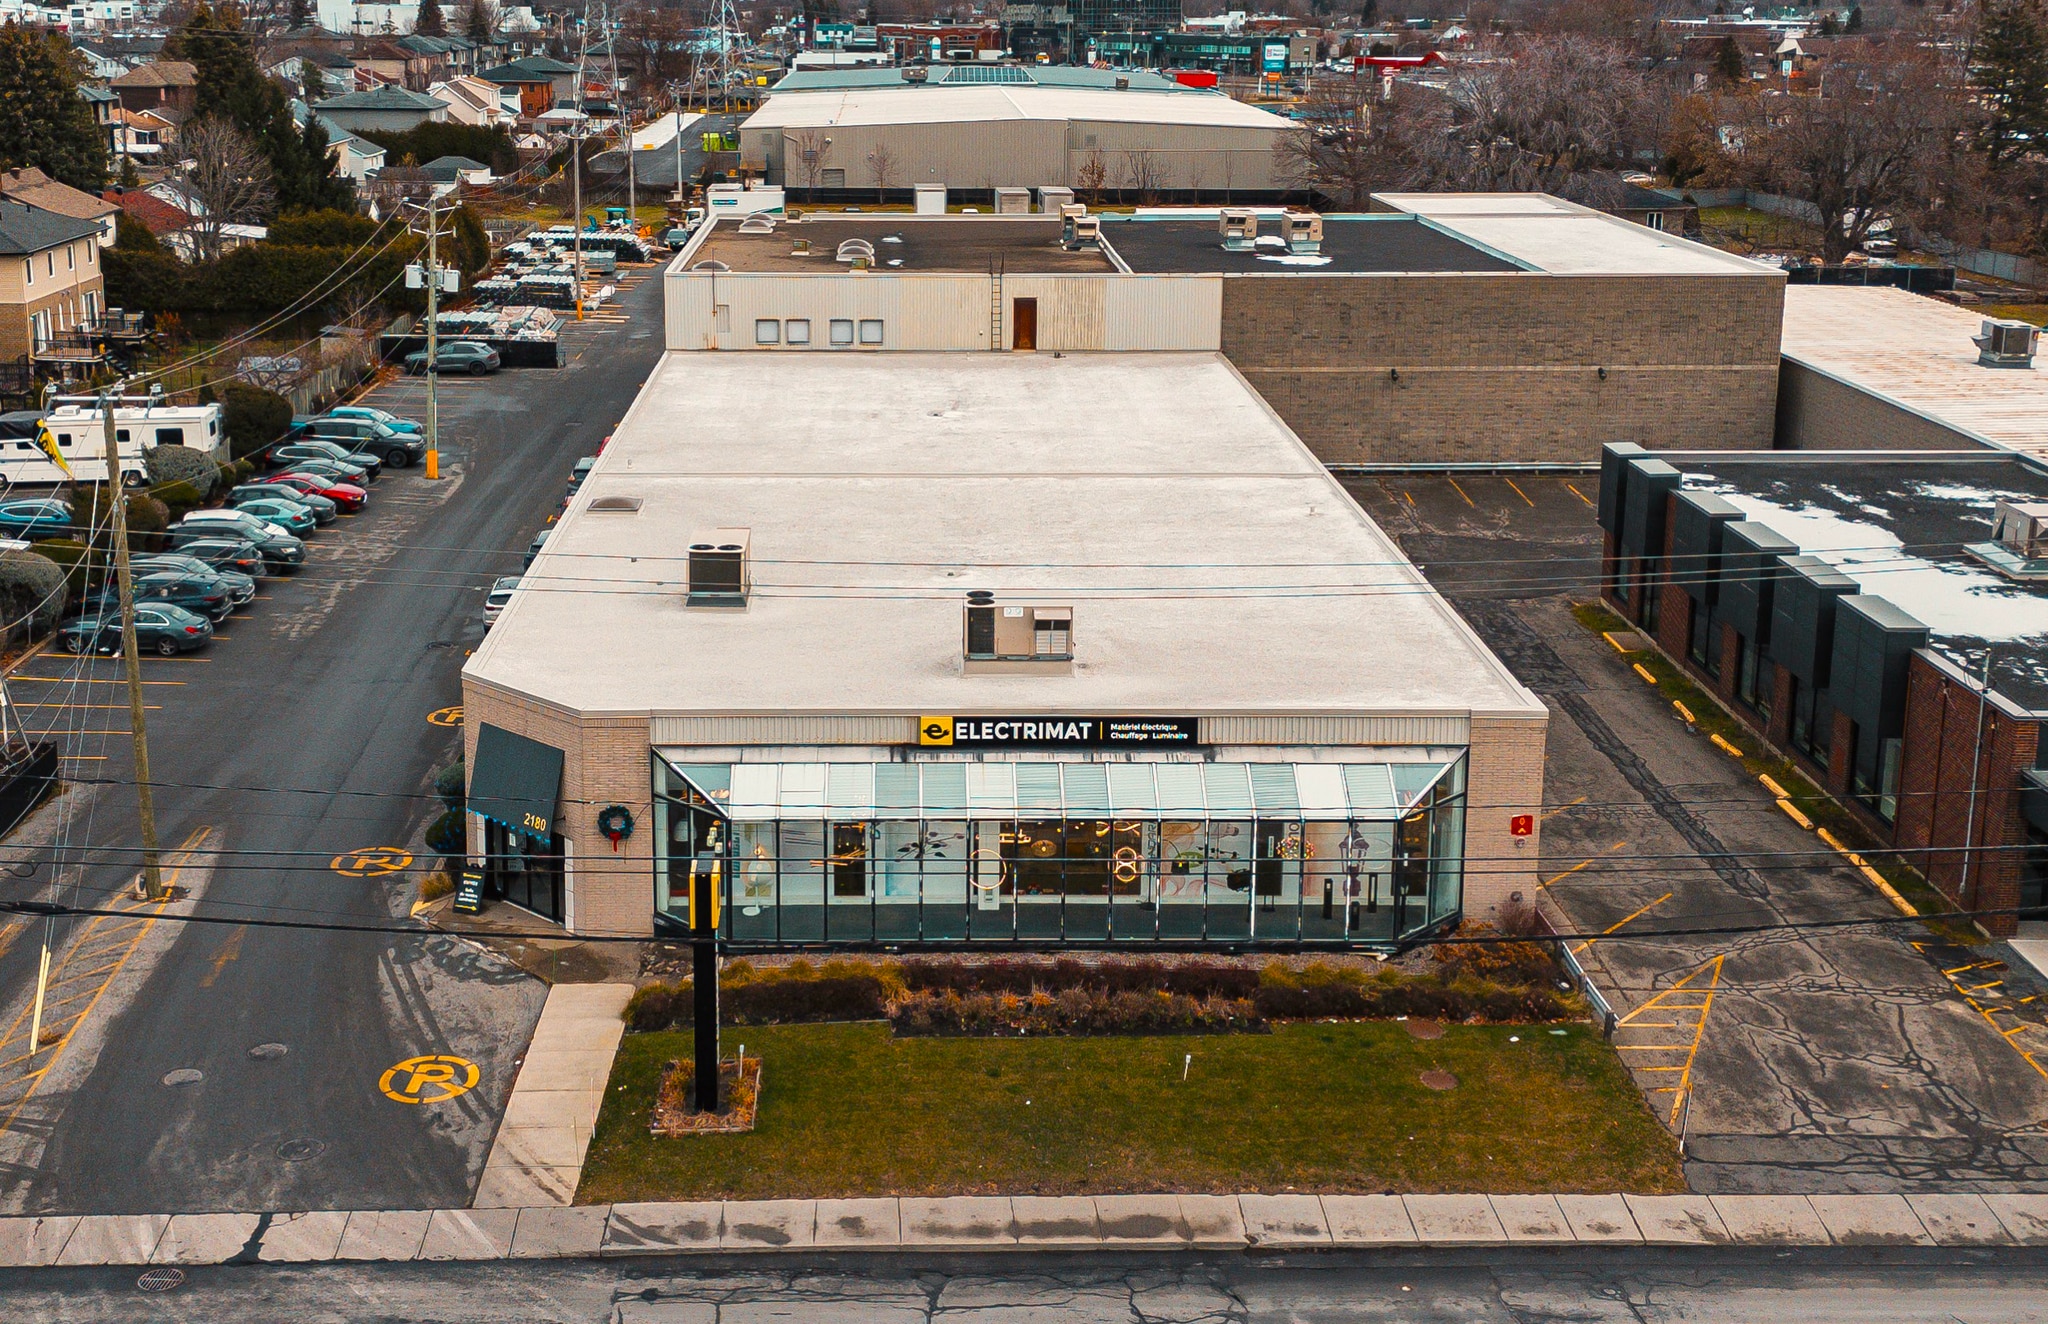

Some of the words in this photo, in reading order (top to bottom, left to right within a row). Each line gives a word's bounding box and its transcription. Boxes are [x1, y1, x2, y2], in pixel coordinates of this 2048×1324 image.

[955, 722, 1093, 740] ELECTRIMAT
[1110, 723, 1141, 731] Matériel
[1141, 723, 1178, 732] électrique
[1110, 732, 1148, 741] Chauffage
[523, 812, 547, 832] 2180
